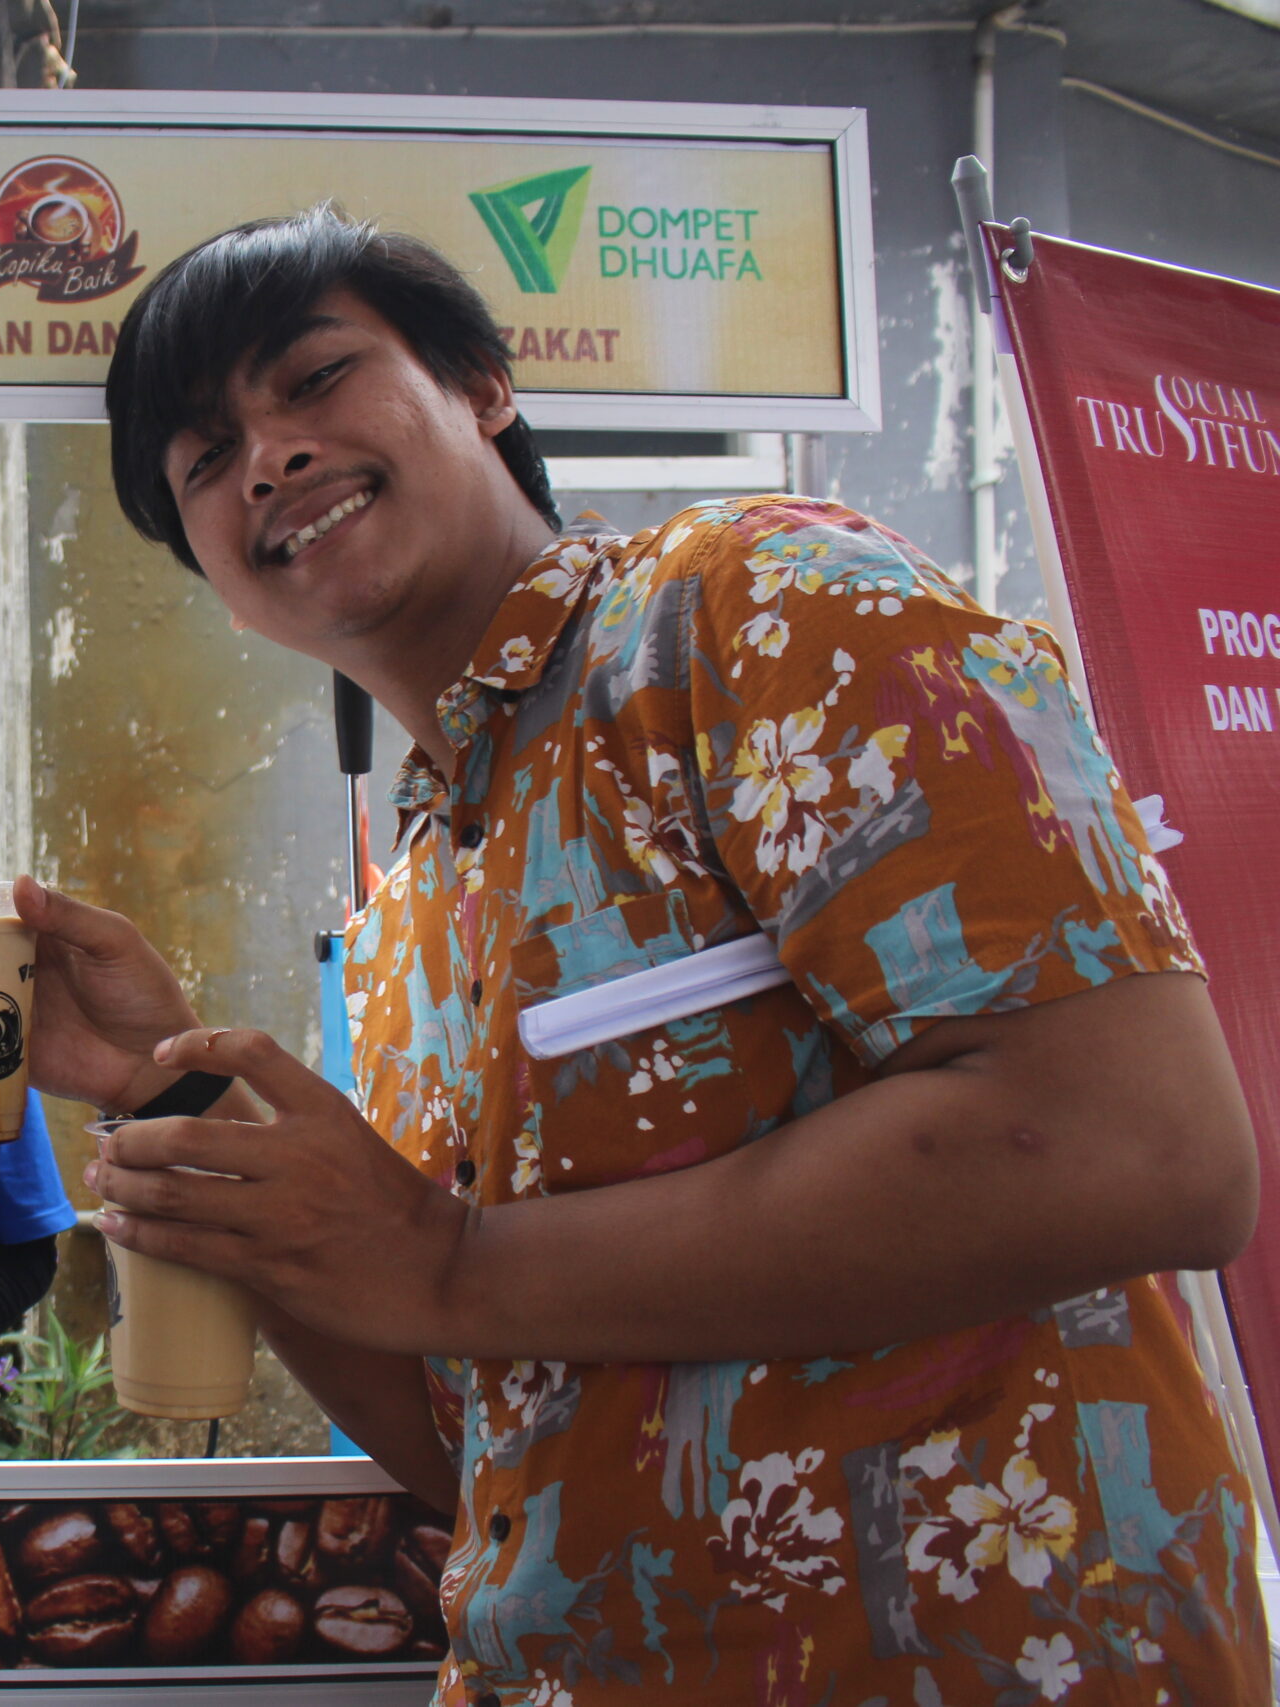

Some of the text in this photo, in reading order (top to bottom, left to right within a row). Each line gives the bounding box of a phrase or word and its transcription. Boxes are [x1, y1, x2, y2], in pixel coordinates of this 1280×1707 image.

[597, 205, 759, 241] DOMPET
[63, 259, 118, 295] Baik
[599, 244, 764, 281] DHUAFA
[496, 326, 620, 363] ZAKAT
[1198, 607, 1280, 660] PROG
[1203, 684, 1273, 732] DAN
